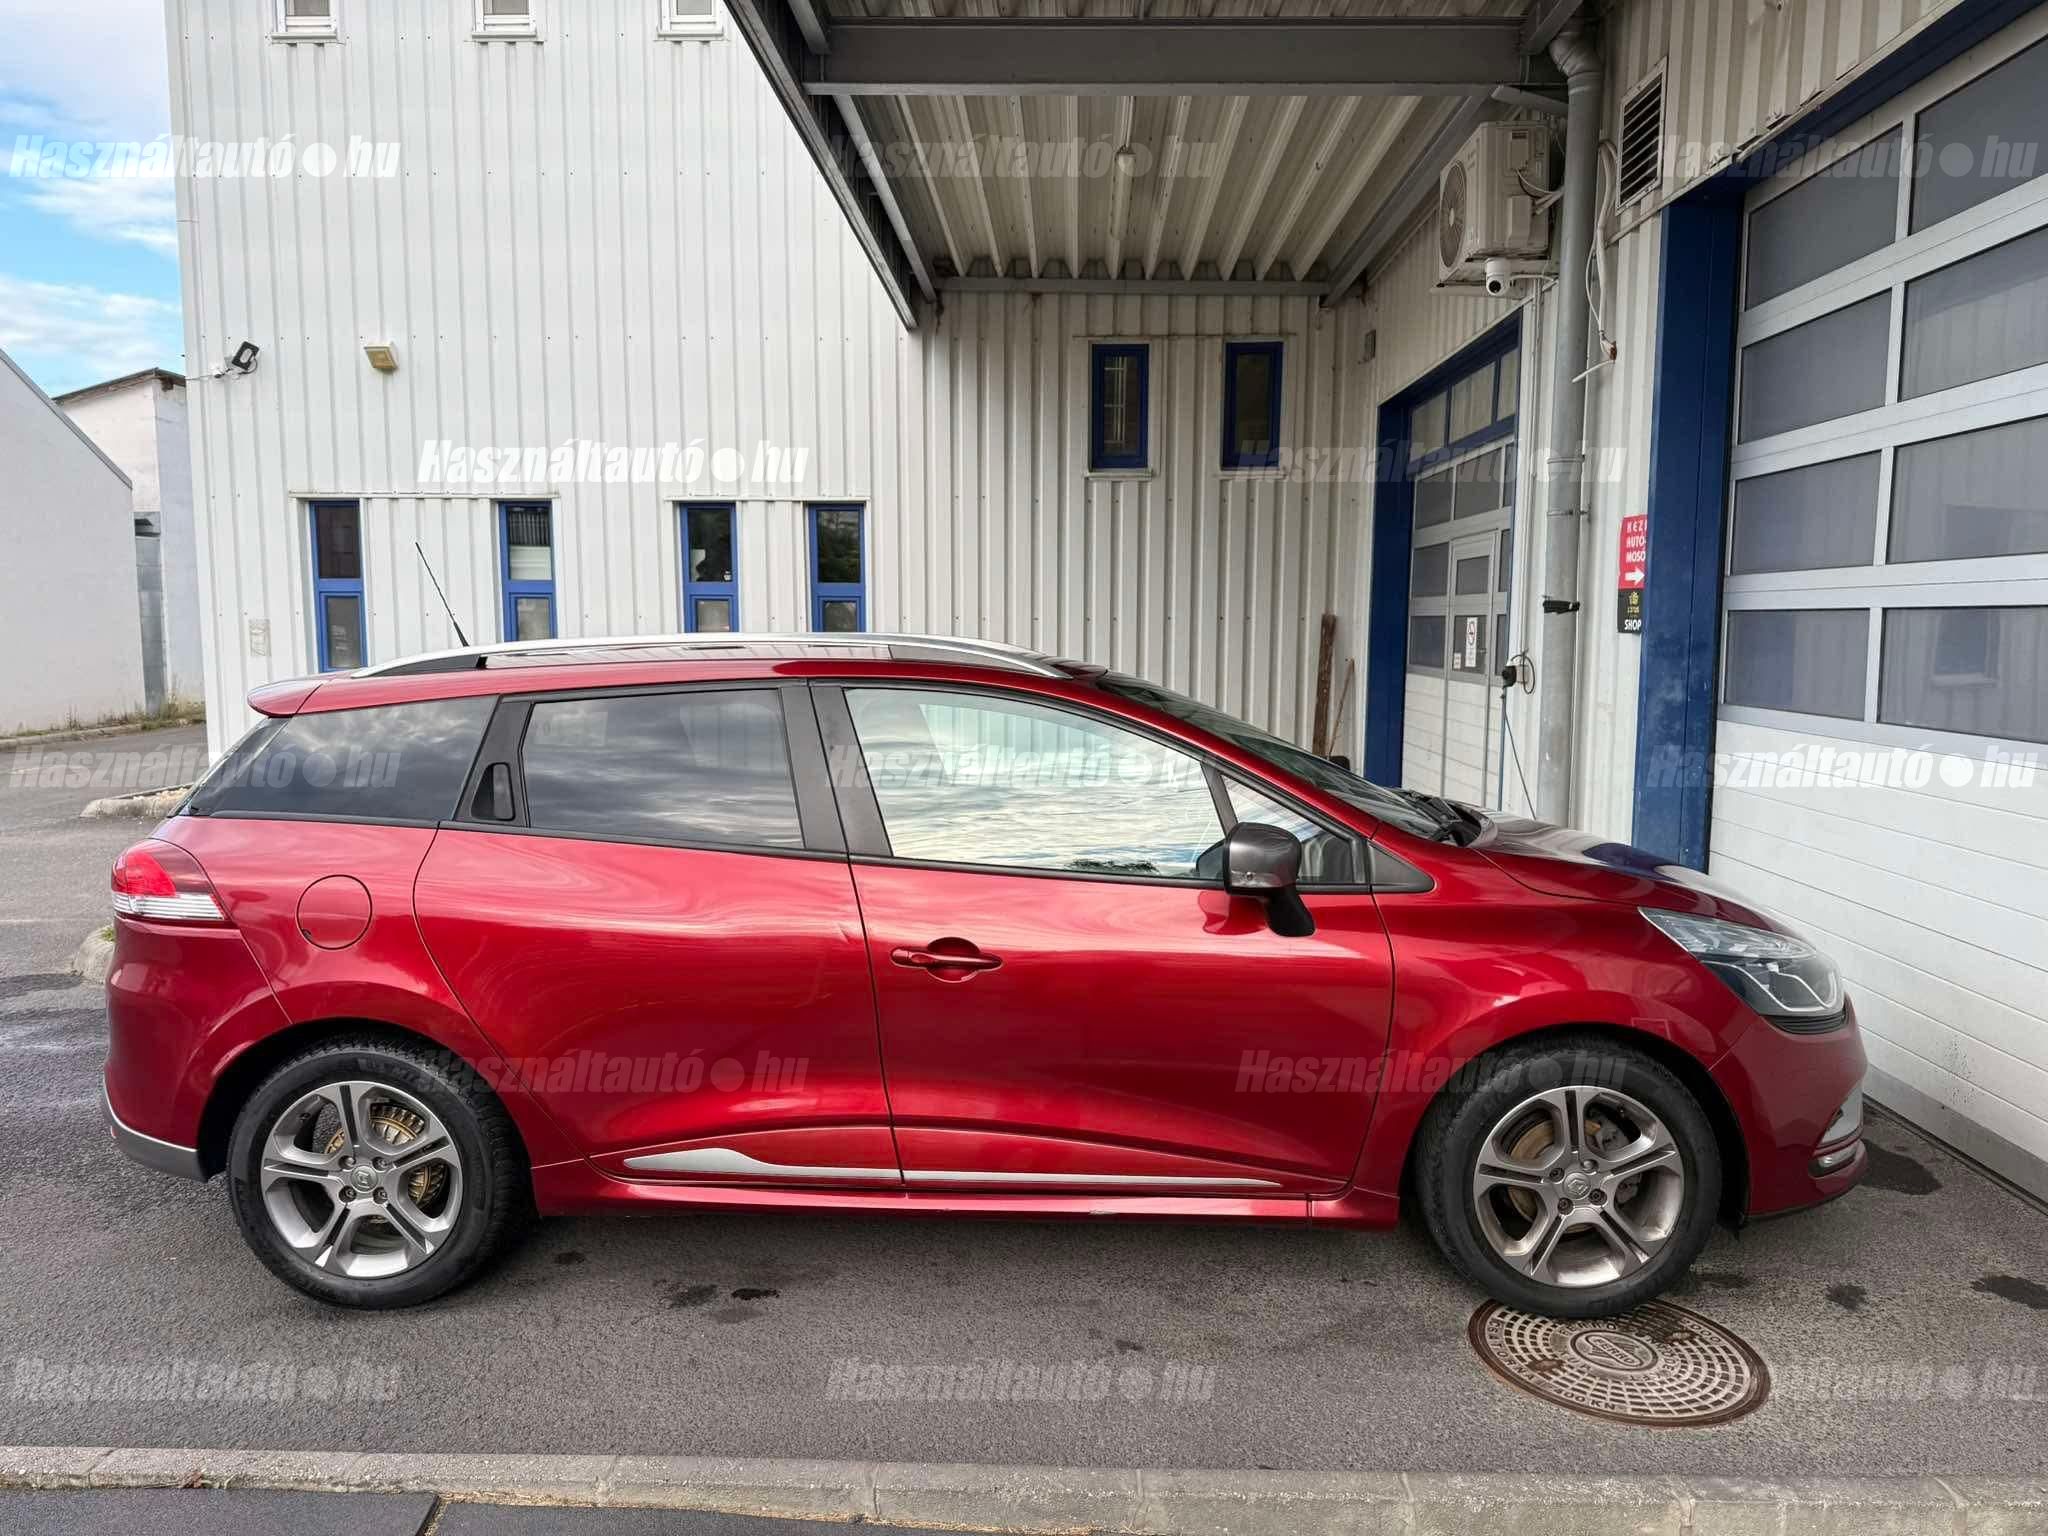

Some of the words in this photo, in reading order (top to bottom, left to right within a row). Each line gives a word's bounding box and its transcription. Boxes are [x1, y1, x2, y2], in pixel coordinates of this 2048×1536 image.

[1624, 618, 1642, 631] SHOP
[1592, 1338, 1636, 1364] FERRO
[1590, 1399, 1616, 1411] KN
